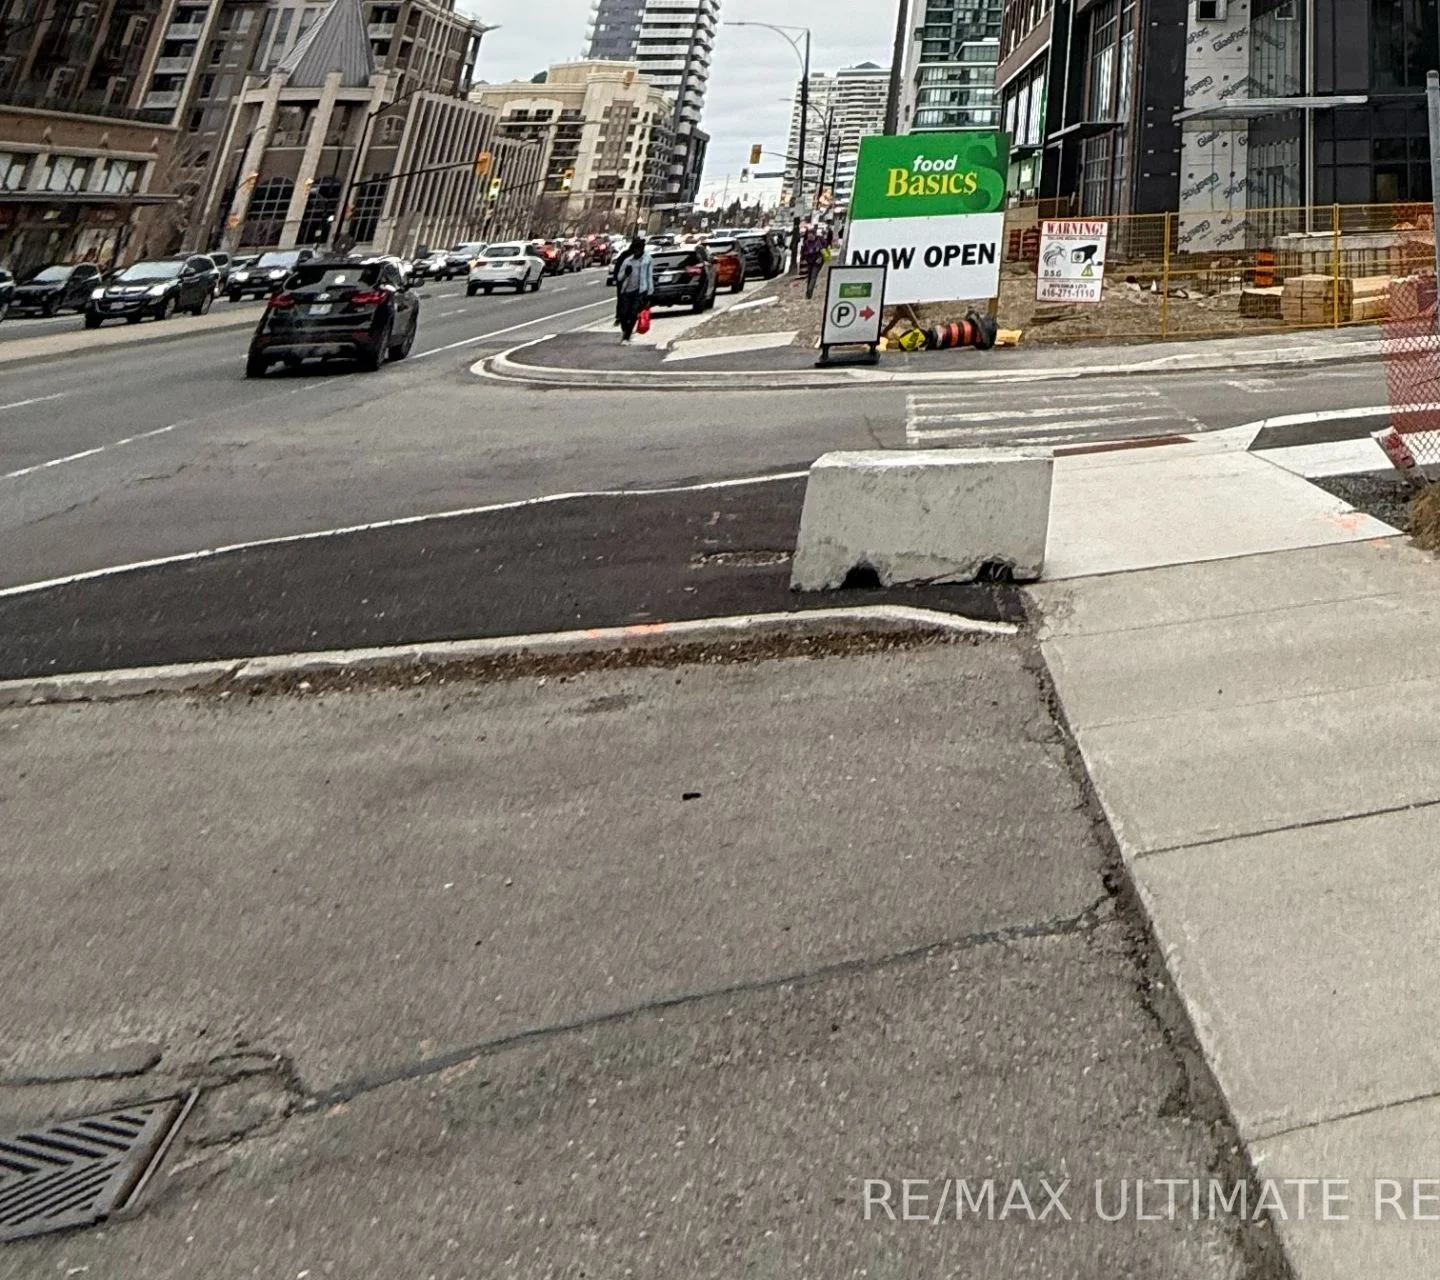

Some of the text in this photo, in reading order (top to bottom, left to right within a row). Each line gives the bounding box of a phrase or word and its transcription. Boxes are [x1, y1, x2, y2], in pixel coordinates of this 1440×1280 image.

[912, 153, 958, 172] food
[1047, 222, 1104, 235] WARNING!
[852, 242, 996, 270] NOW OPEN
[836, 306, 850, 324] P
